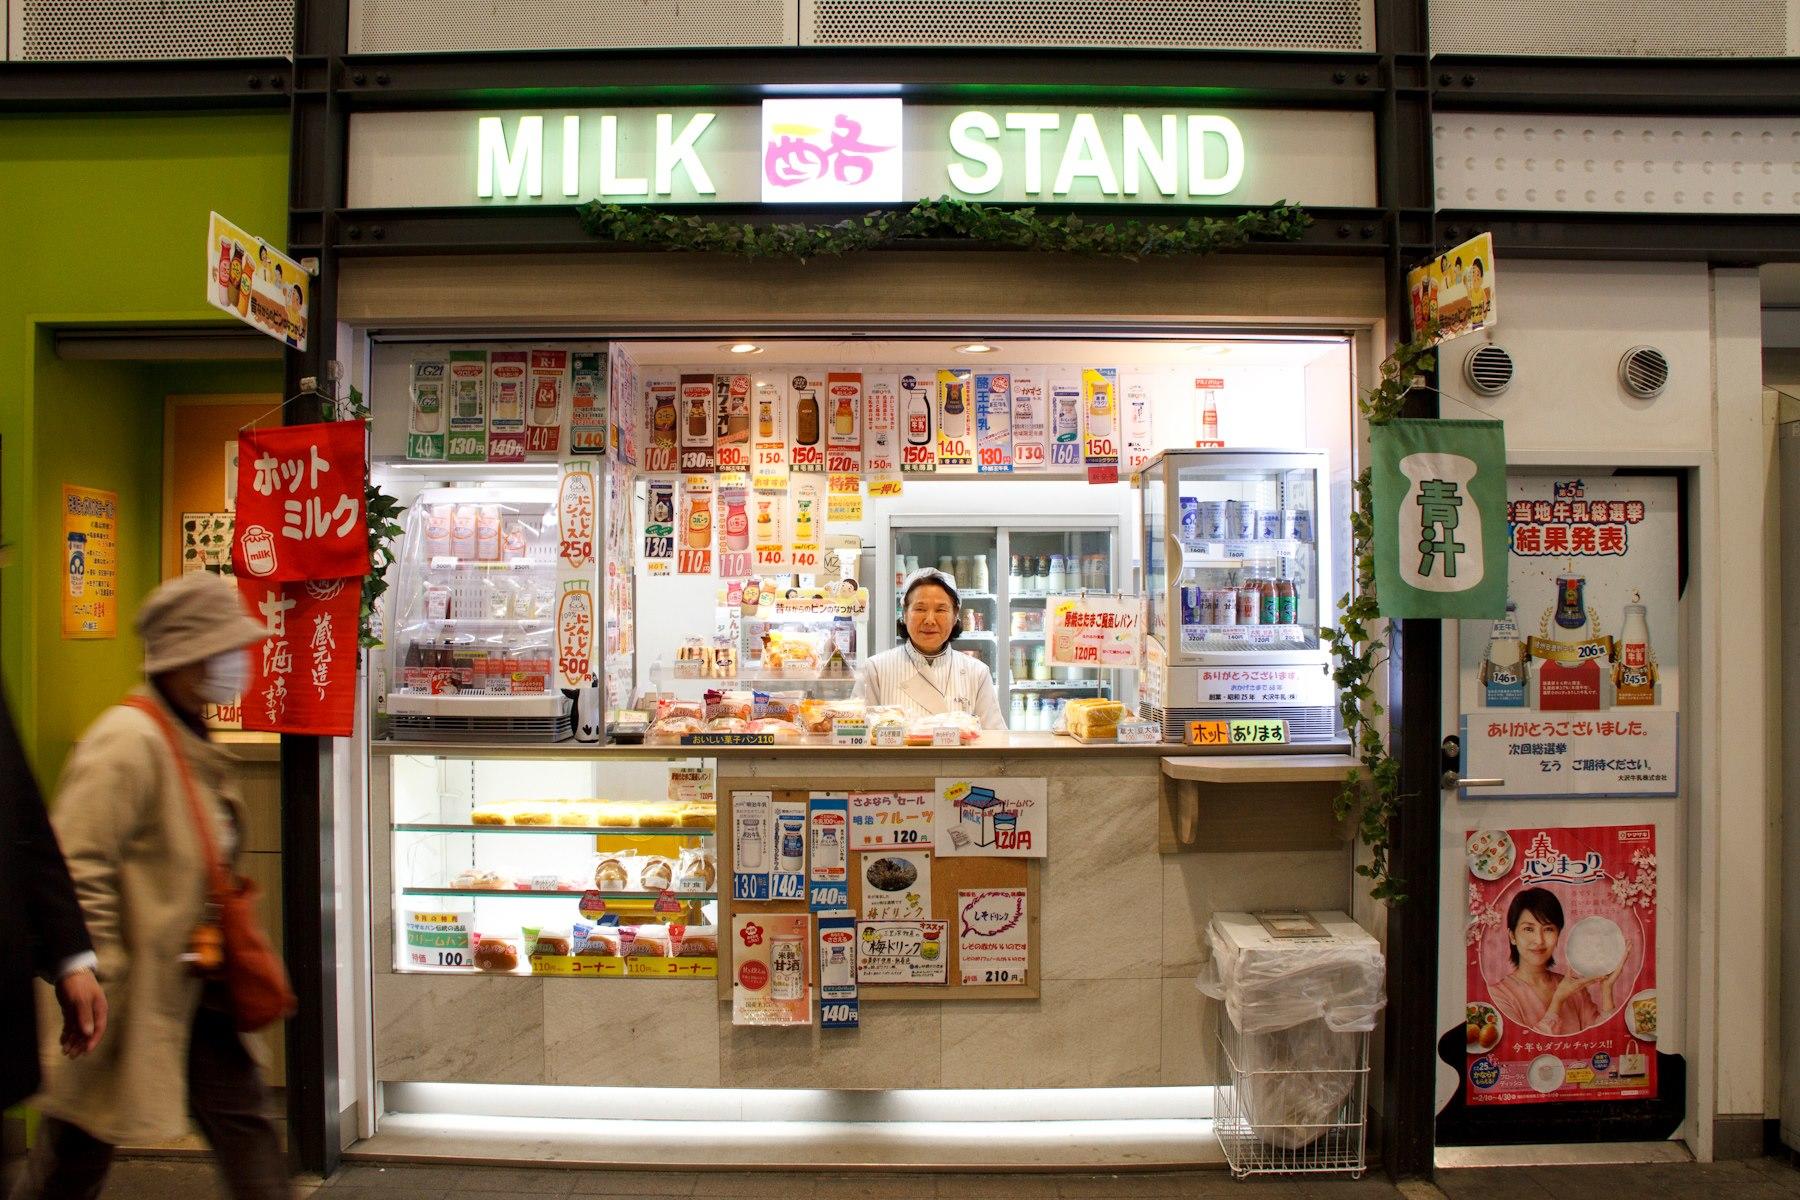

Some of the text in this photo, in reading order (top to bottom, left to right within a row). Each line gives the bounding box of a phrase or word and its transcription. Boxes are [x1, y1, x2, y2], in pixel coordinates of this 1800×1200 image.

[477, 113, 716, 198] MILK
[947, 111, 1245, 196] STAND
[416, 364, 445, 377] LG21
[903, 446, 935, 463] 150円
[938, 440, 971, 456] 140円
[1086, 439, 1118, 455] 150円
[682, 452, 714, 468] 130円
[792, 447, 823, 464] 150円
[979, 448, 1011, 465] 130円
[253, 445, 330, 496] ホット
[828, 457, 860, 472] 120円
[869, 460, 892, 469] 150円
[829, 476, 860, 492] 特売
[869, 484, 901, 494] 一押し
[282, 494, 359, 540] ミルク
[578, 495, 592, 538] にんじん
[1507, 502, 1644, 523] 当地牛乳総選挙
[1416, 478, 1466, 578] 青汁
[1516, 526, 1623, 552] 結果発表
[250, 549, 271, 561] milk
[775, 603, 866, 614] 昔ながらのビンのなつかしさ
[576, 614, 589, 657] にんじん
[1075, 646, 1098, 660] 120円
[1193, 724, 1283, 743] ホット あります
[1487, 721, 1648, 737] ありがとうございました。
[1508, 743, 1568, 756] 次回総選挙
[1540, 759, 1652, 772] 乞う ご期待ください。
[1618, 774, 1667, 782] 大沢牛乳株式会社
[853, 795, 926, 807] さよなら セール
[876, 810, 934, 825] フルーツ
[893, 830, 917, 843] 120
[995, 830, 1032, 849] 120円
[1525, 853, 1601, 877] パンまつり
[773, 875, 804, 898] 140円
[811, 888, 847, 905] 140円
[974, 911, 1009, 921] しそドリンク
[869, 940, 921, 956] 梅ドリンク
[438, 952, 463, 966] 100
[572, 962, 616, 972] コーナー
[774, 961, 800, 971] 甘酒
[668, 963, 712, 973] コーナー
[986, 971, 1009, 982] 210
[821, 1005, 858, 1021] 140円
